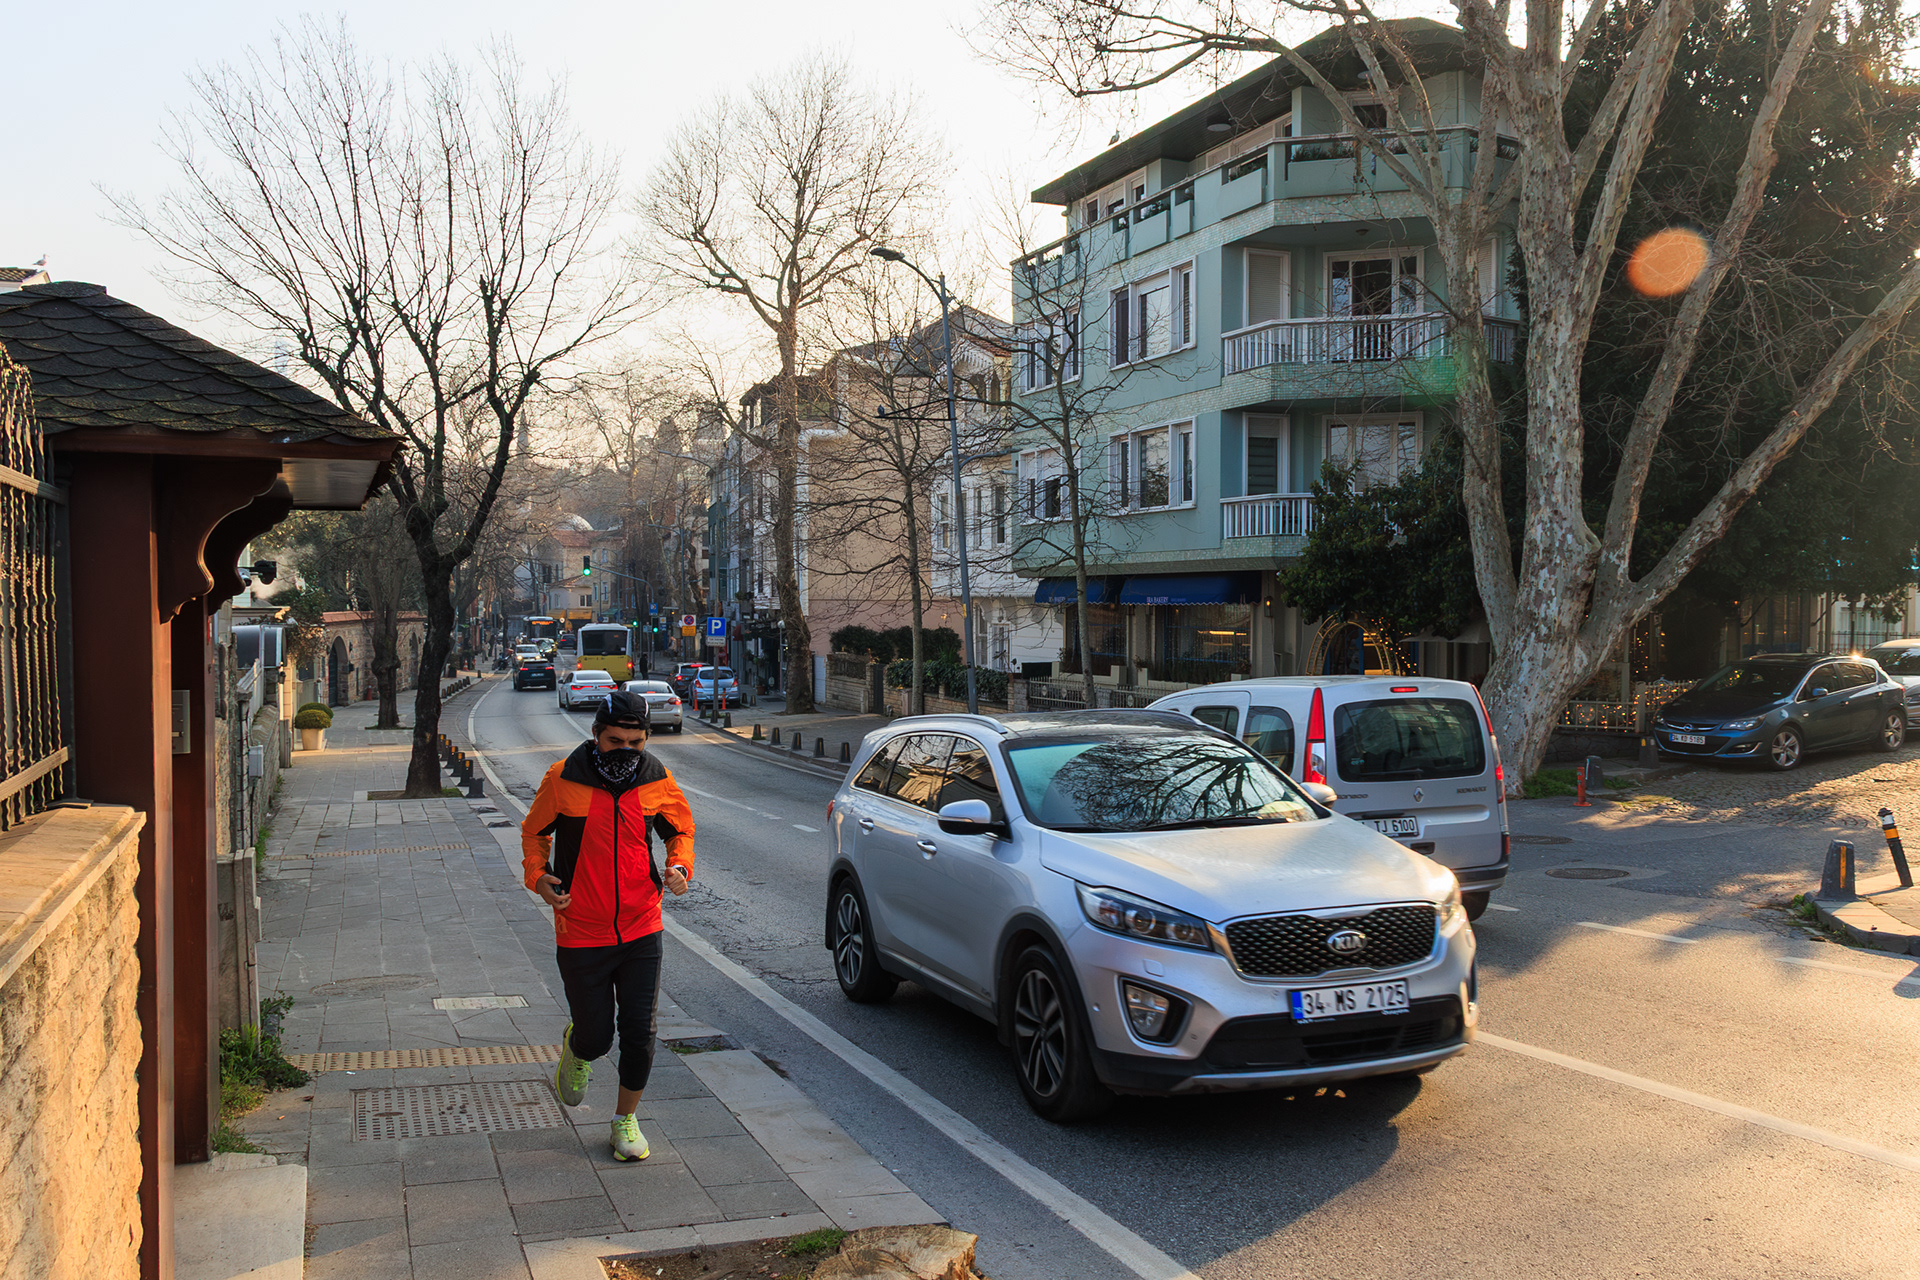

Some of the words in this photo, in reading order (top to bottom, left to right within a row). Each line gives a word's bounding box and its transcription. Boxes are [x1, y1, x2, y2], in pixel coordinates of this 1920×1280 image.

[711, 619, 722, 634] P
[1456, 786, 1487, 794] RENAULT
[1392, 819, 1415, 832] 6100
[1334, 936, 1363, 950] KIA
[1303, 992, 1325, 1015] 34
[1365, 984, 1407, 1009] 2125
